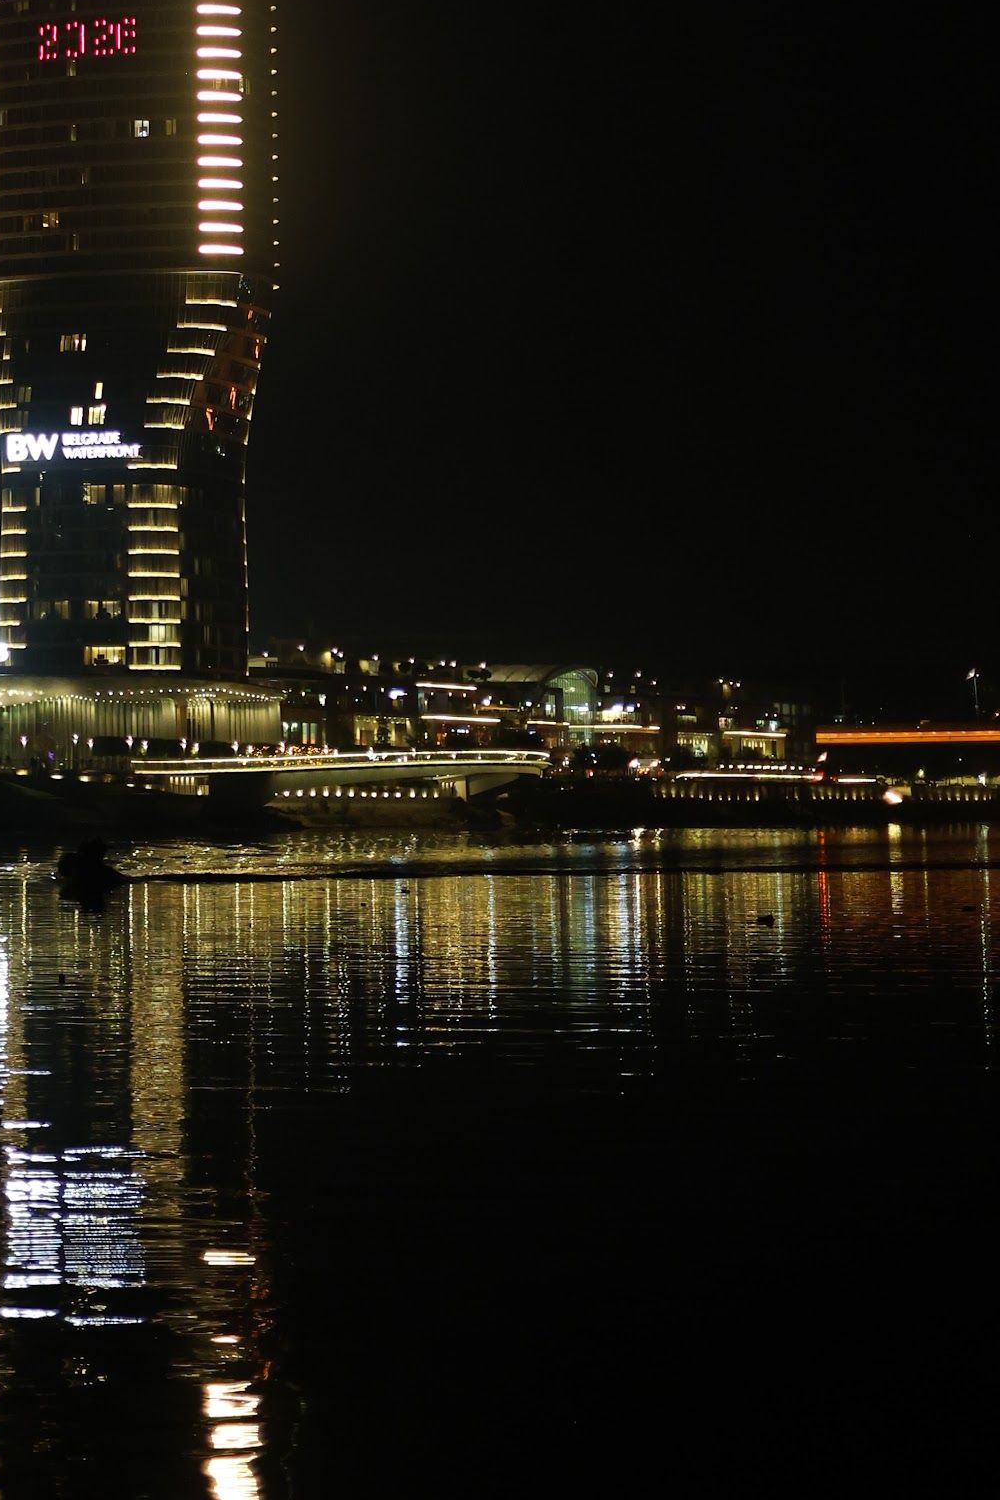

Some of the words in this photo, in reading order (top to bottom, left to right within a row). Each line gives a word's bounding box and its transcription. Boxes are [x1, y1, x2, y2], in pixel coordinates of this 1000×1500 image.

[62, 432, 121, 446] BELGRADE
[7, 434, 58, 462] BW
[62, 445, 140, 459] WATERFRONT
